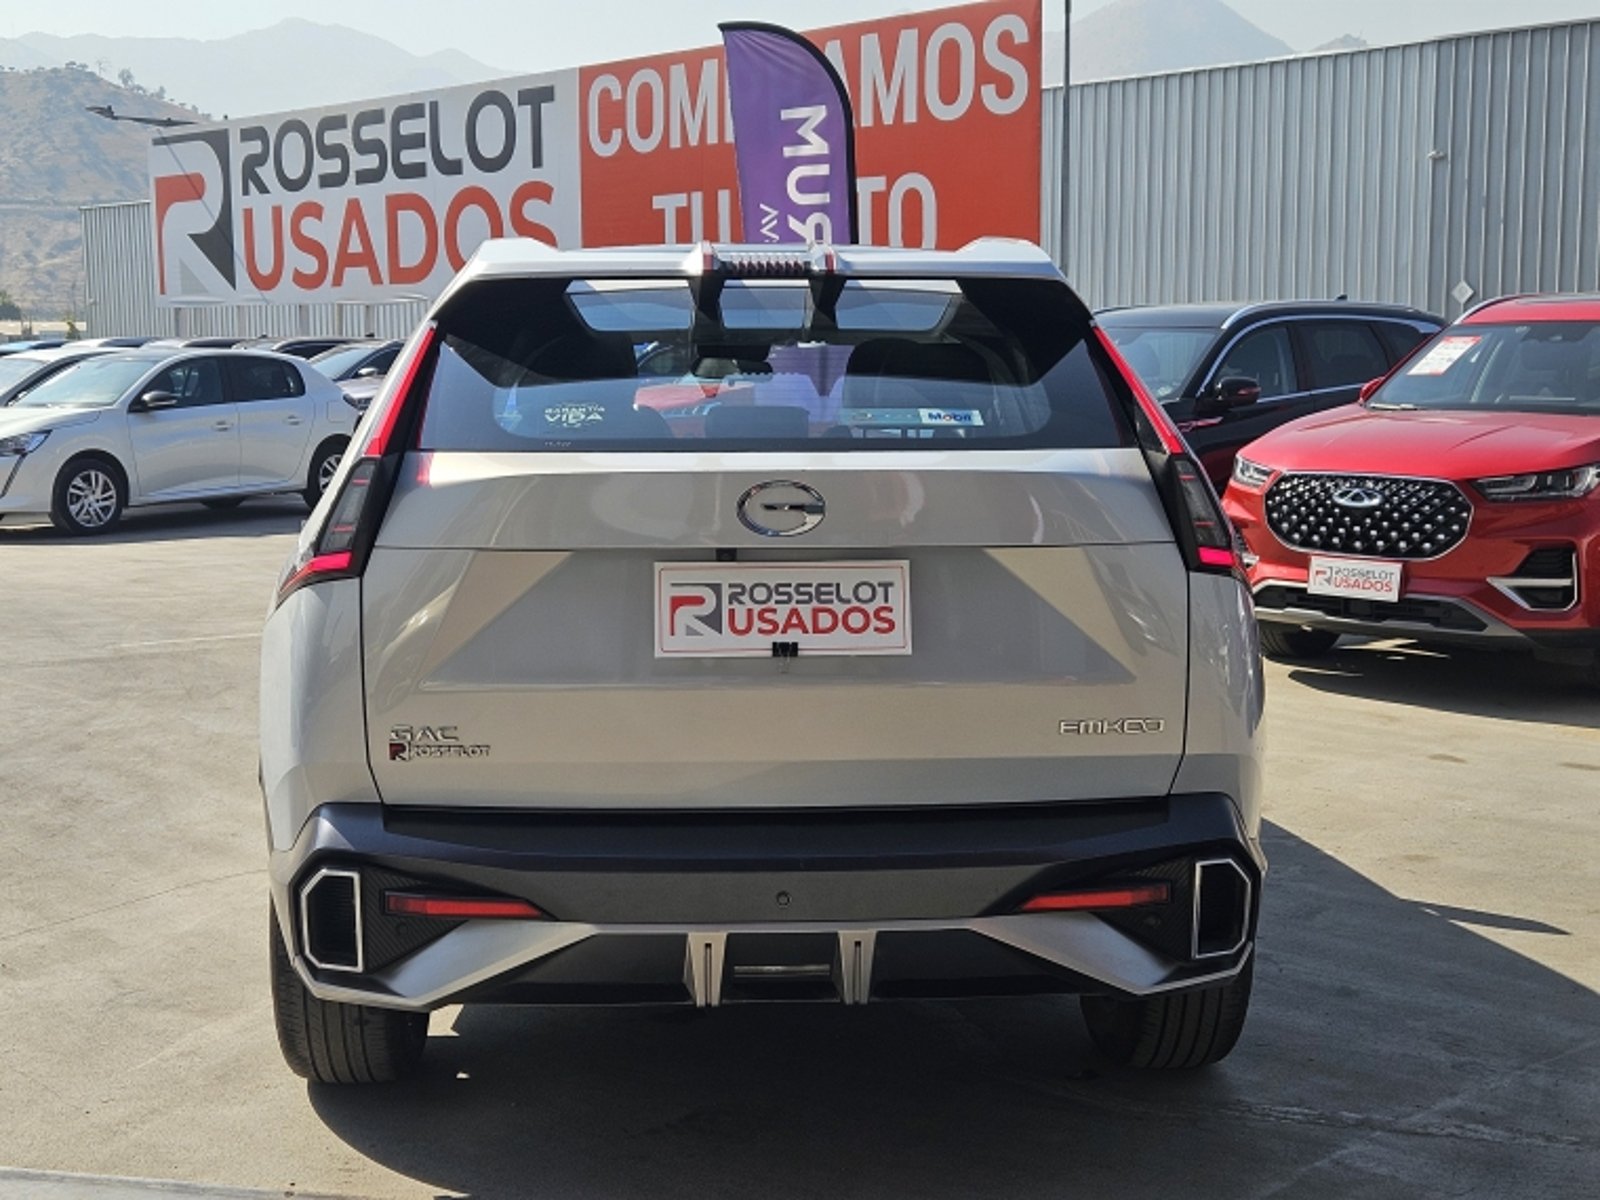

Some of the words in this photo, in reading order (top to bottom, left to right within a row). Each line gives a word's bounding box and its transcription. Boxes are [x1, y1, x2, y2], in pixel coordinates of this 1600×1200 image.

[240, 85, 556, 196] ROSSELOT
[1334, 567, 1395, 580] ROSSELOT
[1334, 576, 1393, 593] USADOS
[728, 581, 895, 605] ROSSELOT
[728, 606, 896, 636] USADOS
